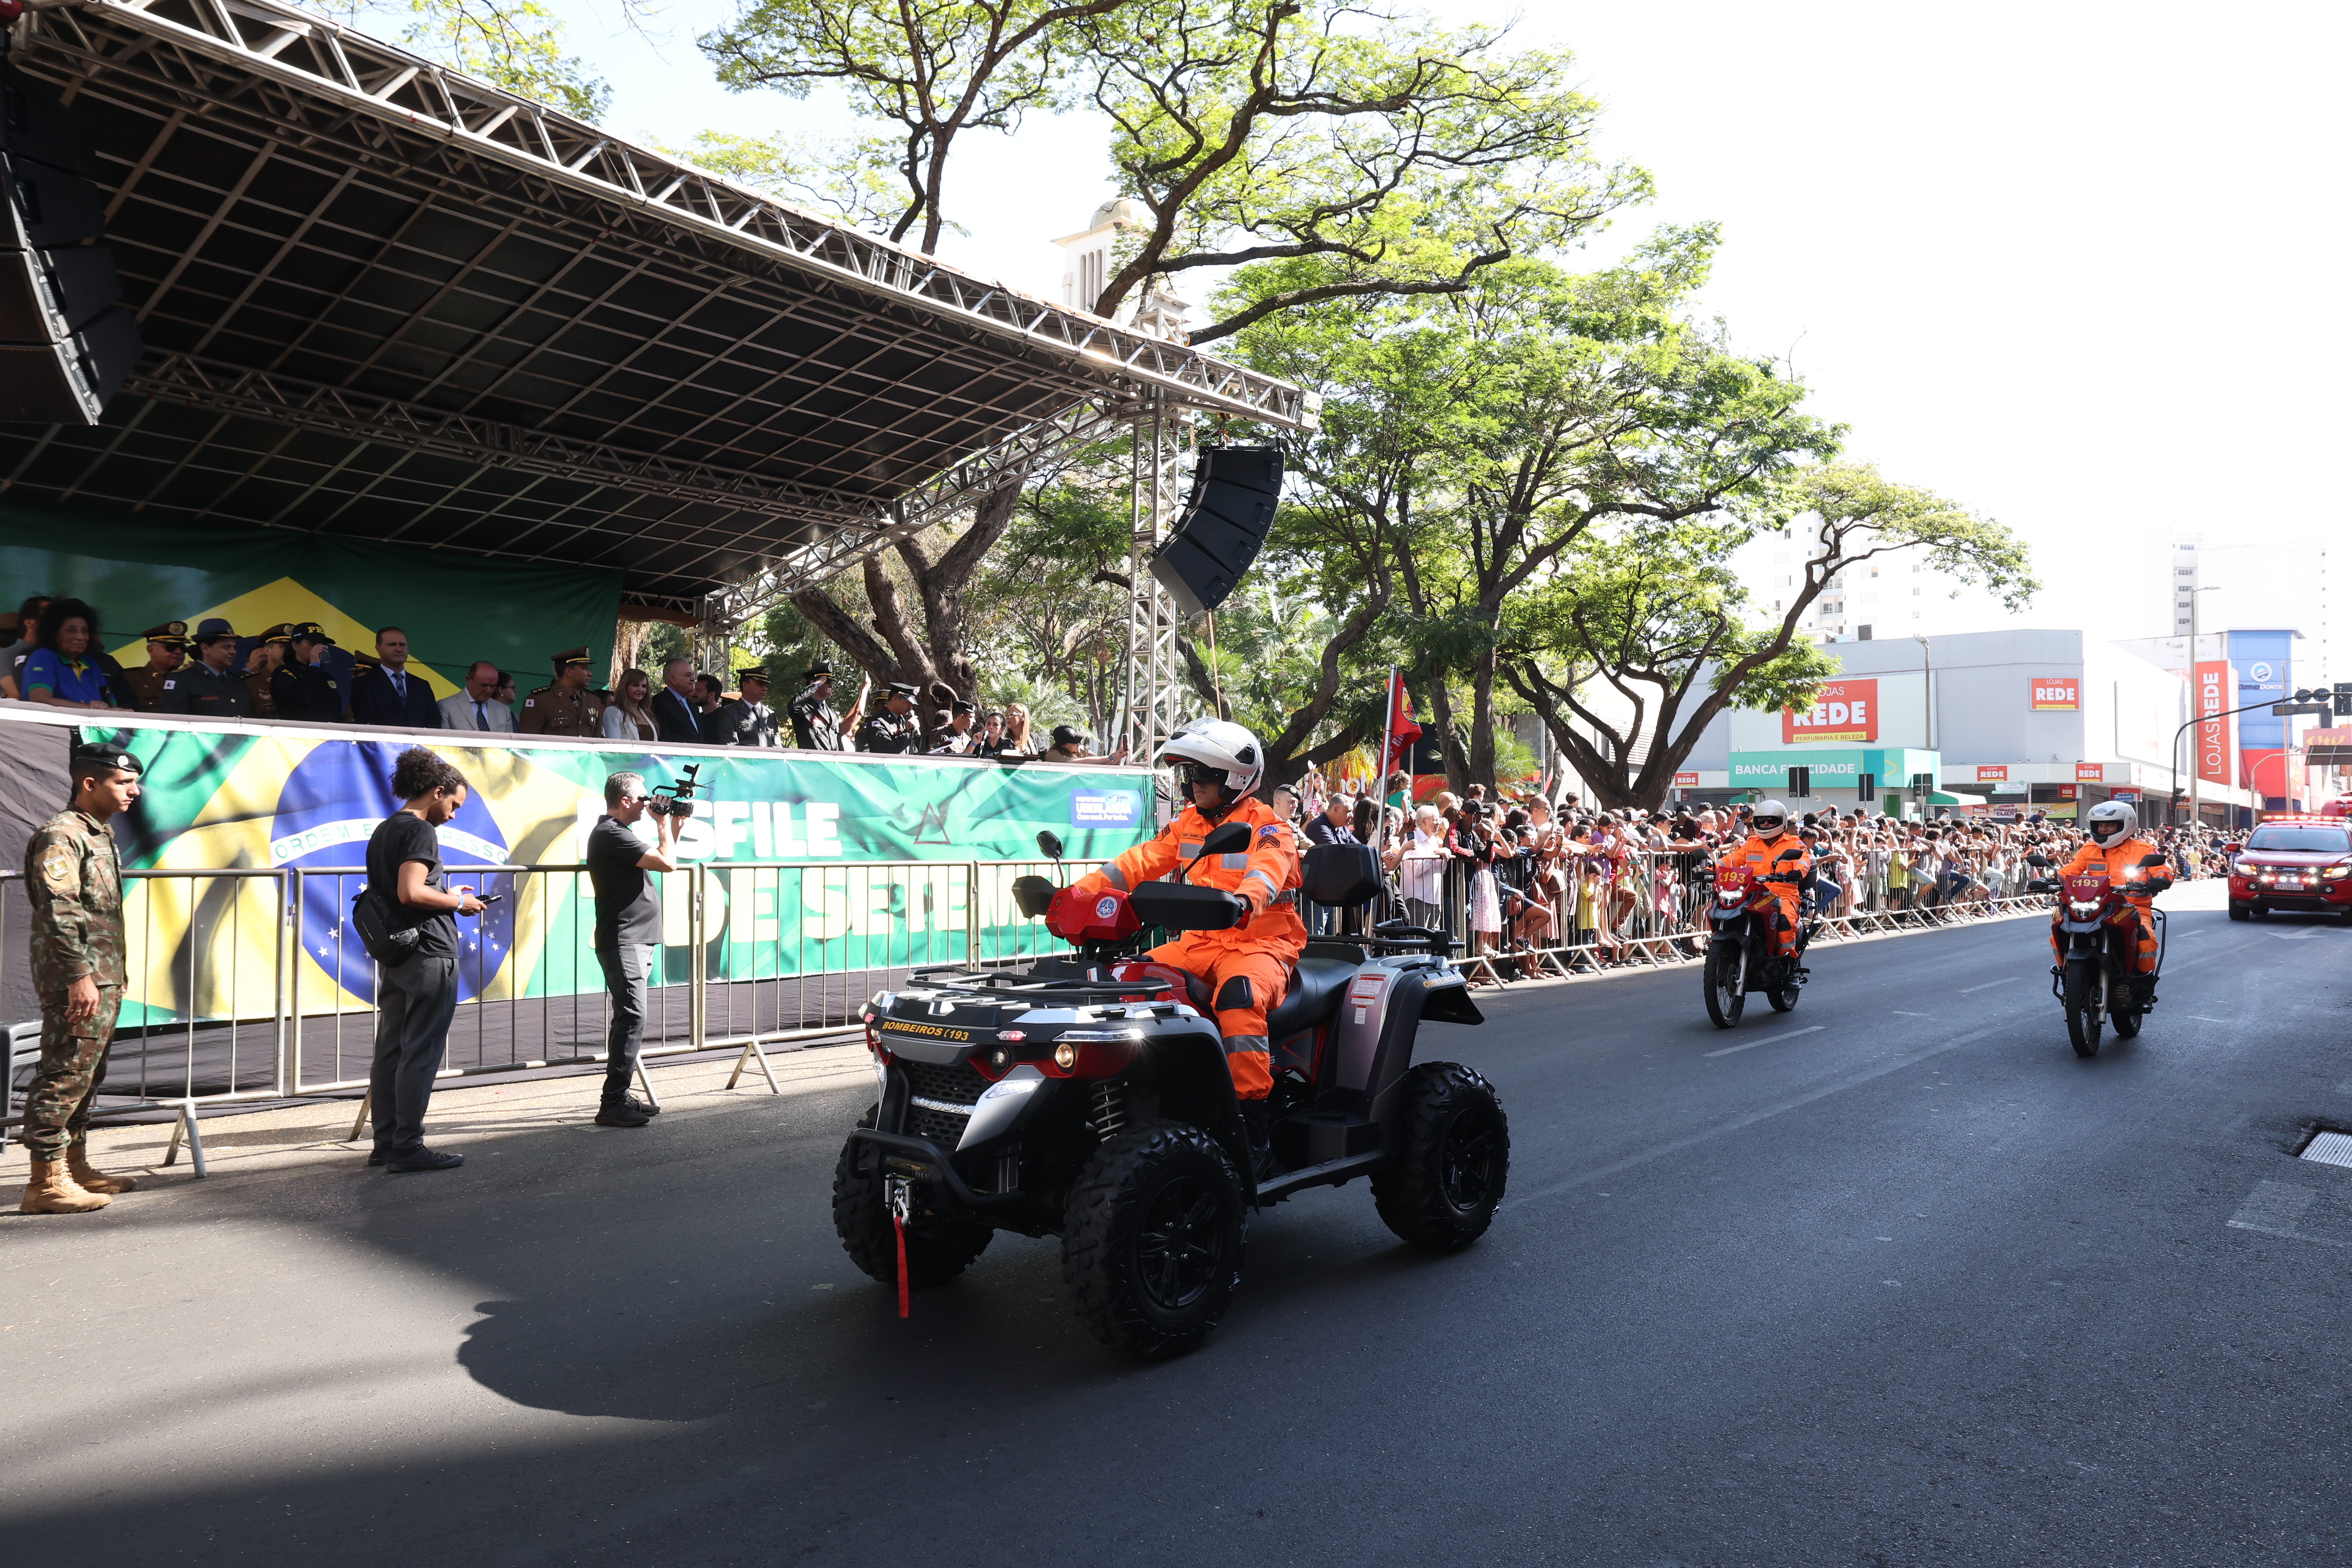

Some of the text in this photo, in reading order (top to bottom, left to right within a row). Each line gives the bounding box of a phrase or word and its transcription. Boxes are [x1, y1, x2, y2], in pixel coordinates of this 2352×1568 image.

[1818, 686, 1844, 697] OJAS
[2036, 688, 2075, 701] REDE
[1735, 763, 1856, 775] BANCA FCIDADE
[1076, 801, 1132, 814] UBERLÂNDIA
[576, 799, 842, 859] SFILE
[275, 824, 508, 864] ORDEM E RESSO
[1723, 872, 1746, 883] 193
[2076, 879, 2098, 887] 193
[664, 866, 778, 947] DE
[882, 1022, 969, 1041] BOMBEIROS 193
